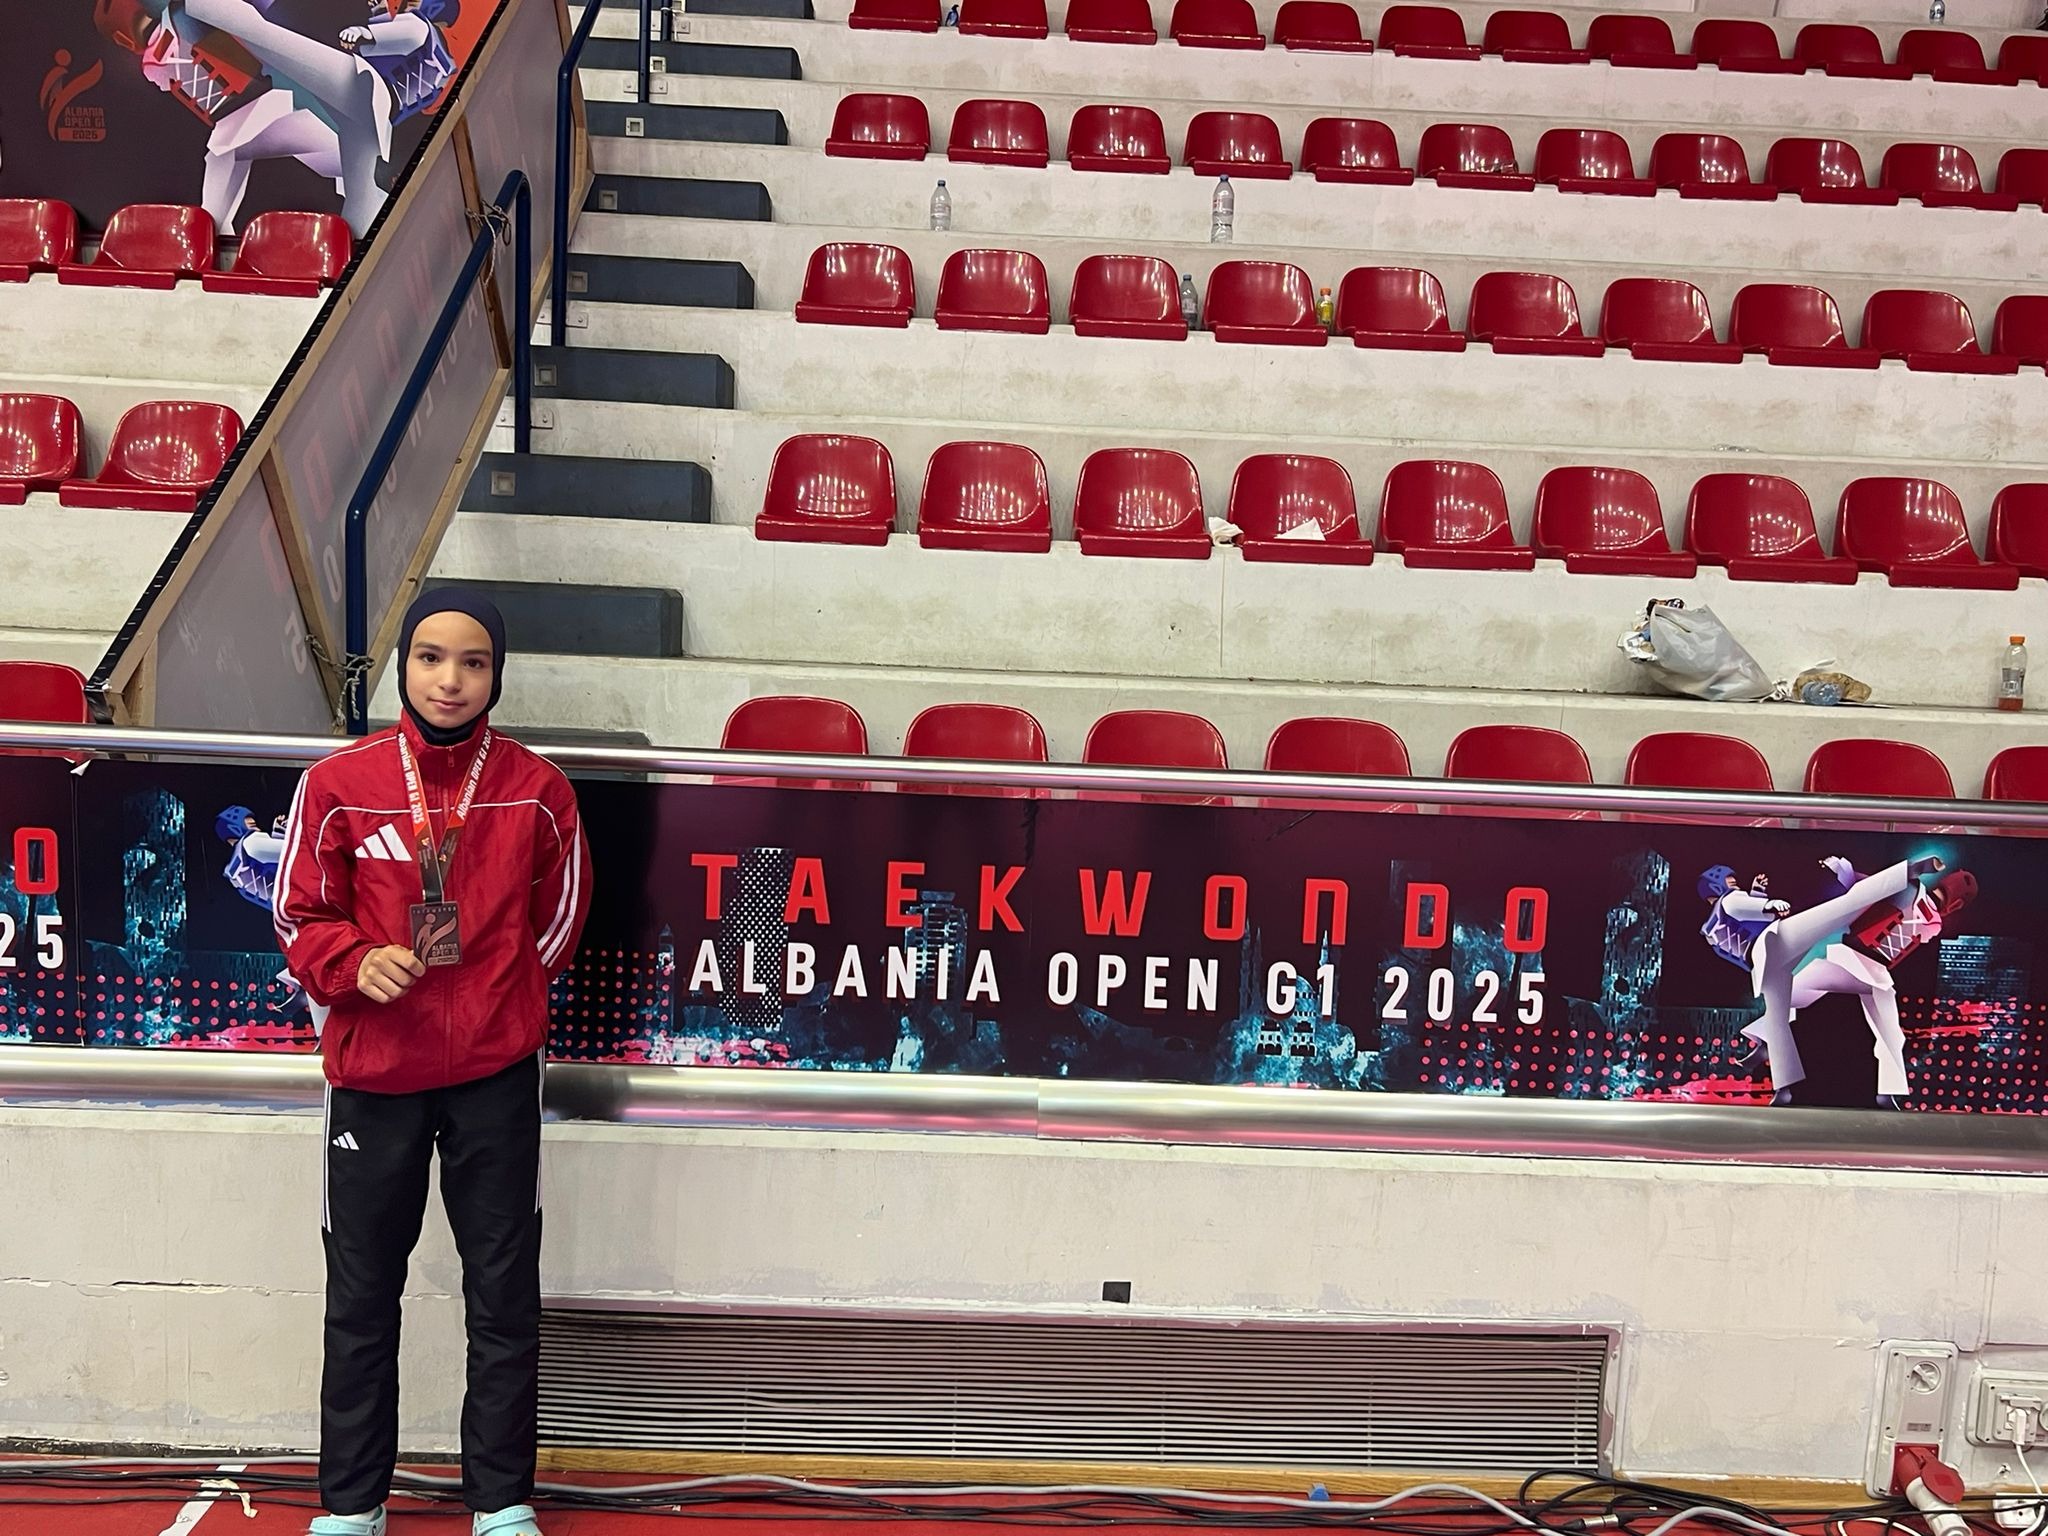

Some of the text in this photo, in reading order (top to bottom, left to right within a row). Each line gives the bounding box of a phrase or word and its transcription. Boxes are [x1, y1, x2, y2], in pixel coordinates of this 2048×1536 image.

[64, 117, 91, 128] OPEN
[65, 107, 104, 117] ALBANIA
[397, 732, 412, 771] Albanian
[405, 771, 418, 791] OPEN
[456, 779, 477, 820] Albanian
[470, 758, 484, 780] OPEN
[411, 802, 425, 824] 2025
[690, 853, 1549, 953] TAEKWONDO
[688, 939, 1546, 1025] ALBANIA OPEN G1 2025
